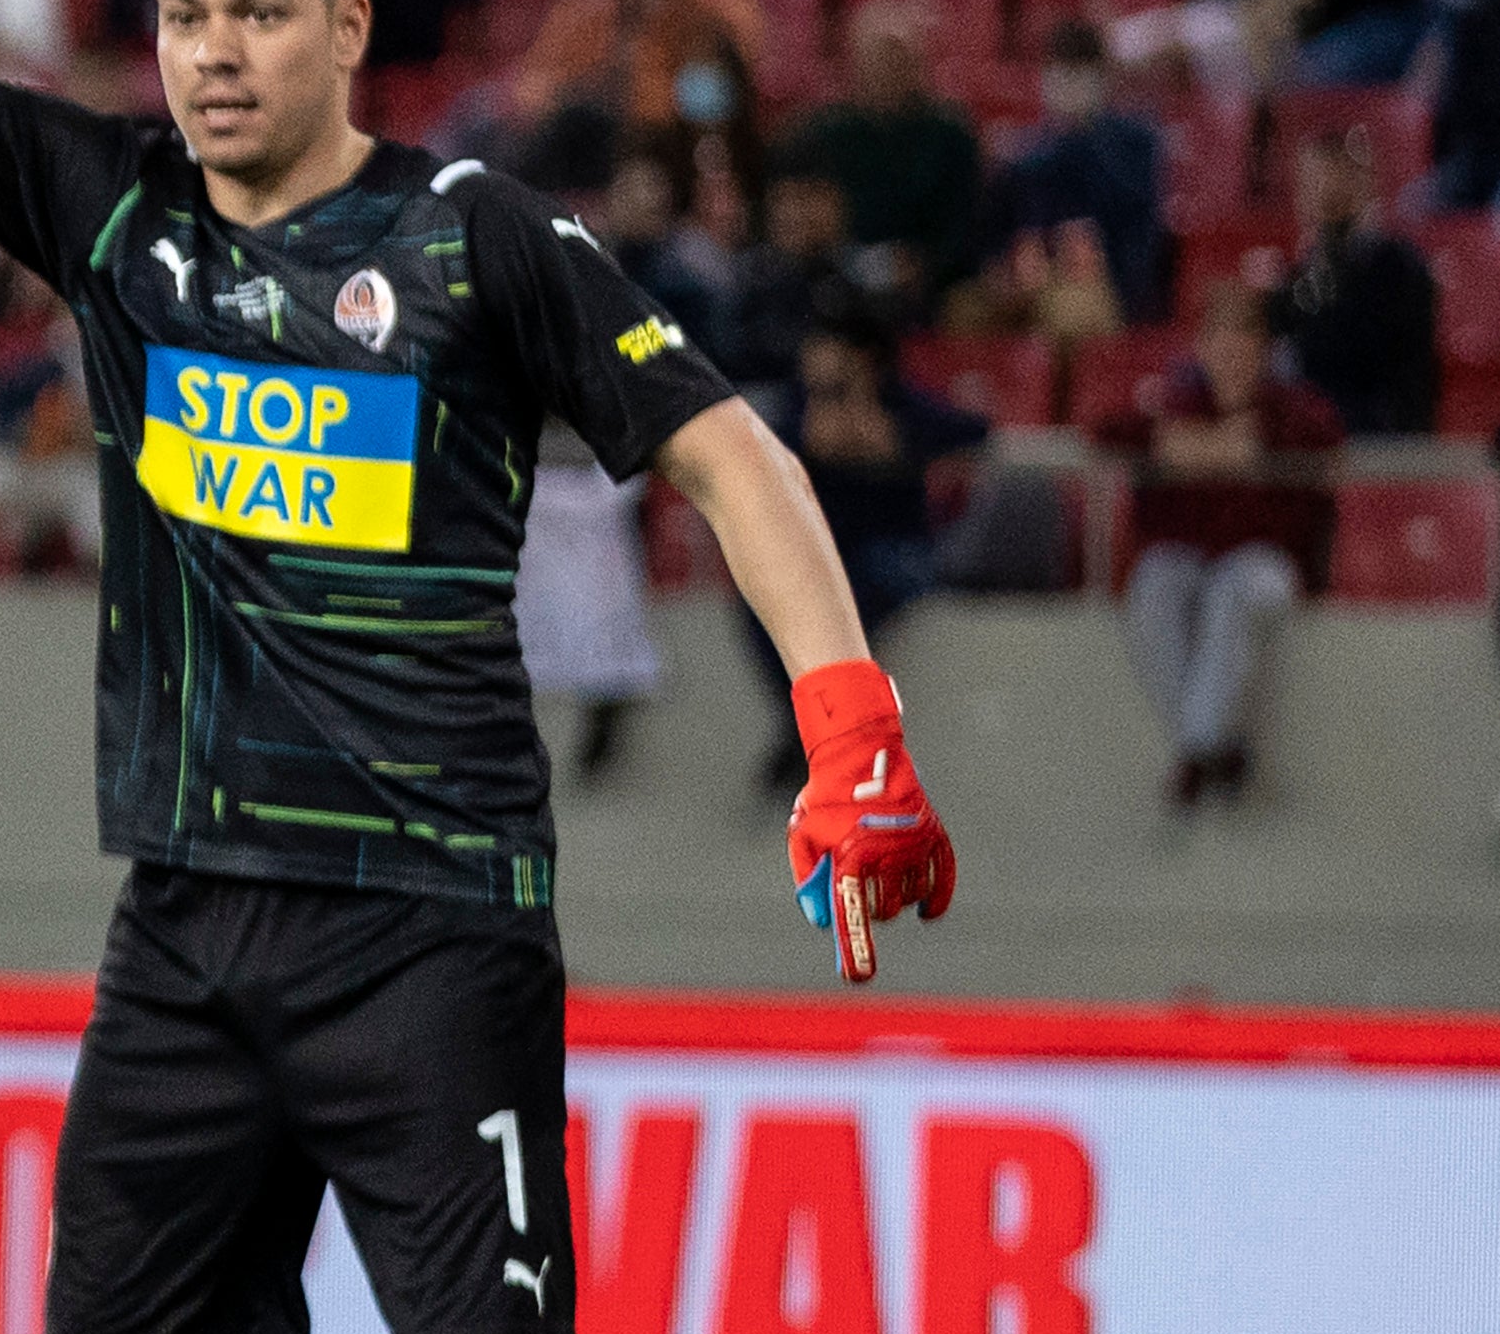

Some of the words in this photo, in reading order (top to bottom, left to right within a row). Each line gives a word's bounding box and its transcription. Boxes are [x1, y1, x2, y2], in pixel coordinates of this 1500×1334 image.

[178, 366, 349, 450] STOP
[189, 445, 337, 529] WAR
[477, 1109, 528, 1235] 1
